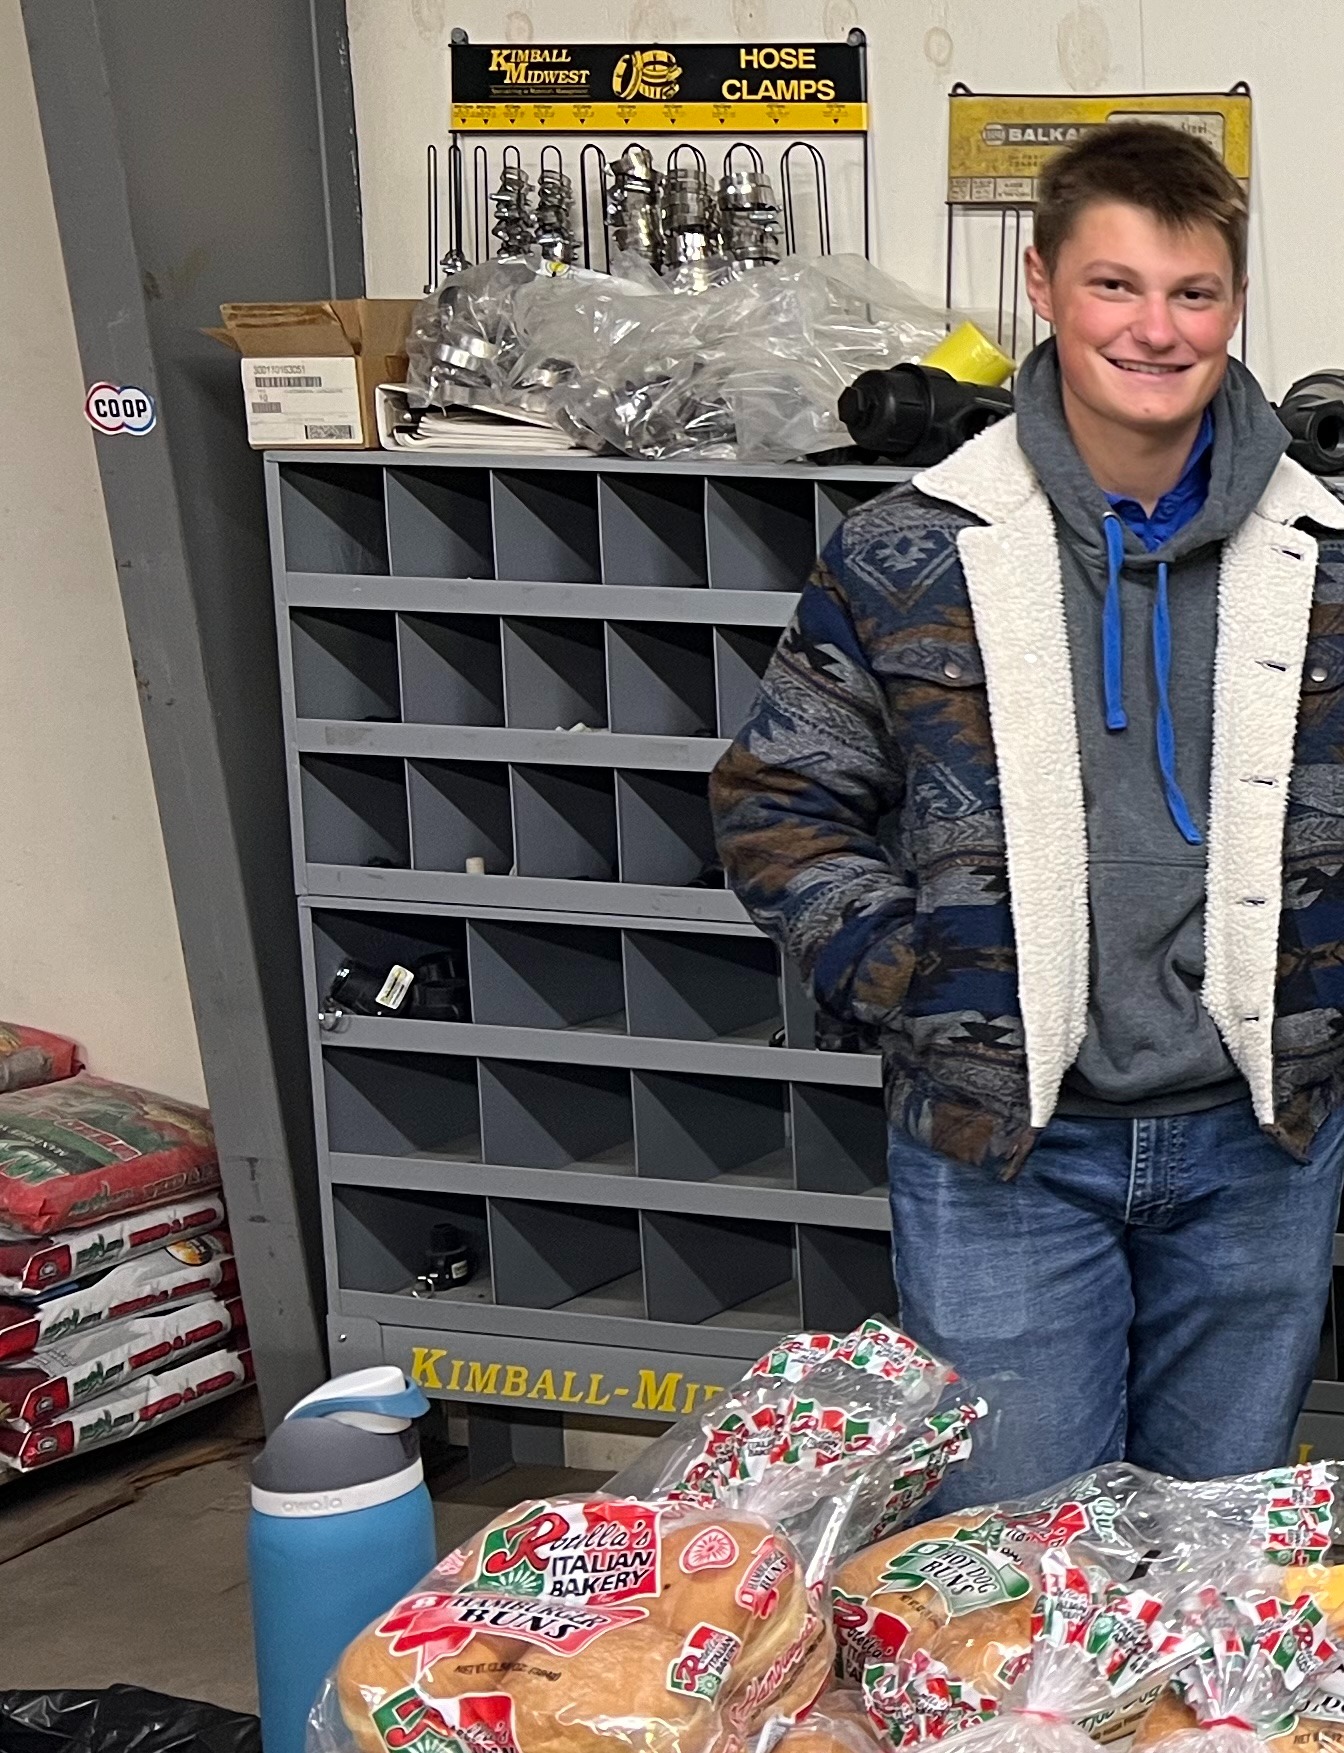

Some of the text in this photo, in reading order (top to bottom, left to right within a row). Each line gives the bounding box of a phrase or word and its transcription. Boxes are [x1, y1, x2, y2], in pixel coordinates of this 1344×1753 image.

[489, 49, 571, 71] KIMBALL
[740, 48, 817, 69] HOSE
[503, 63, 590, 84] MIDWEST
[721, 79, 836, 101] CLAMPS
[551, 1551, 653, 1578] ITALIAN
[919, 1560, 975, 1596] BUNS
[936, 1550, 997, 1593] HOT DOG
[550, 1569, 648, 1597] BAKERY
[452, 1596, 610, 1628] HAMBURGER
[458, 1608, 579, 1640] BUNS
